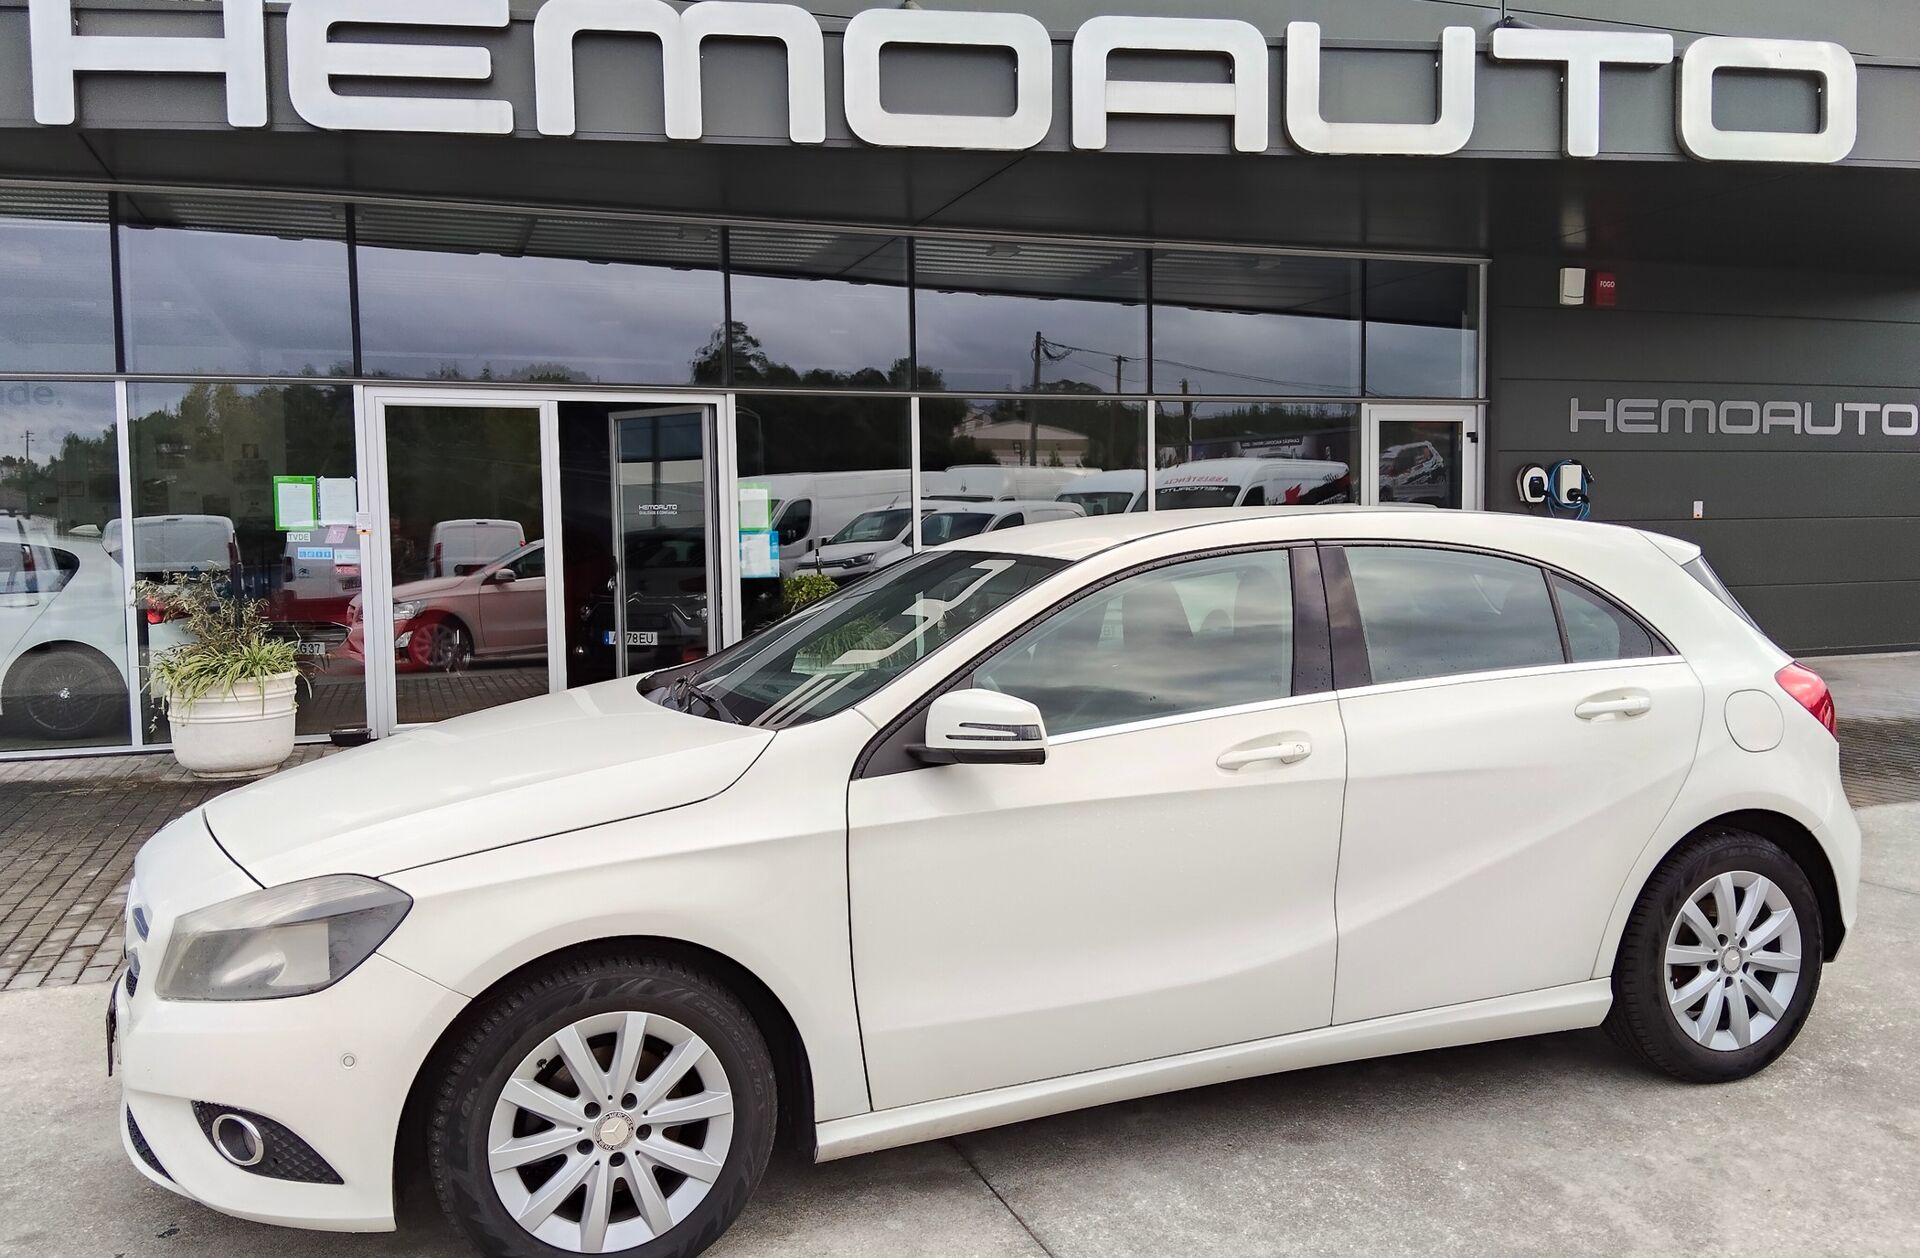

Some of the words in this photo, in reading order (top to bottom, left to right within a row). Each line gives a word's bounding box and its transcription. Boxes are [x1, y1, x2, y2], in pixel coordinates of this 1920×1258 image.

[28, 0, 1858, 164] HEMOAUTO
[1599, 280, 1616, 288] FOGO
[1569, 397, 1918, 436] HEMOAUTO
[287, 533, 310, 541] TVDE
